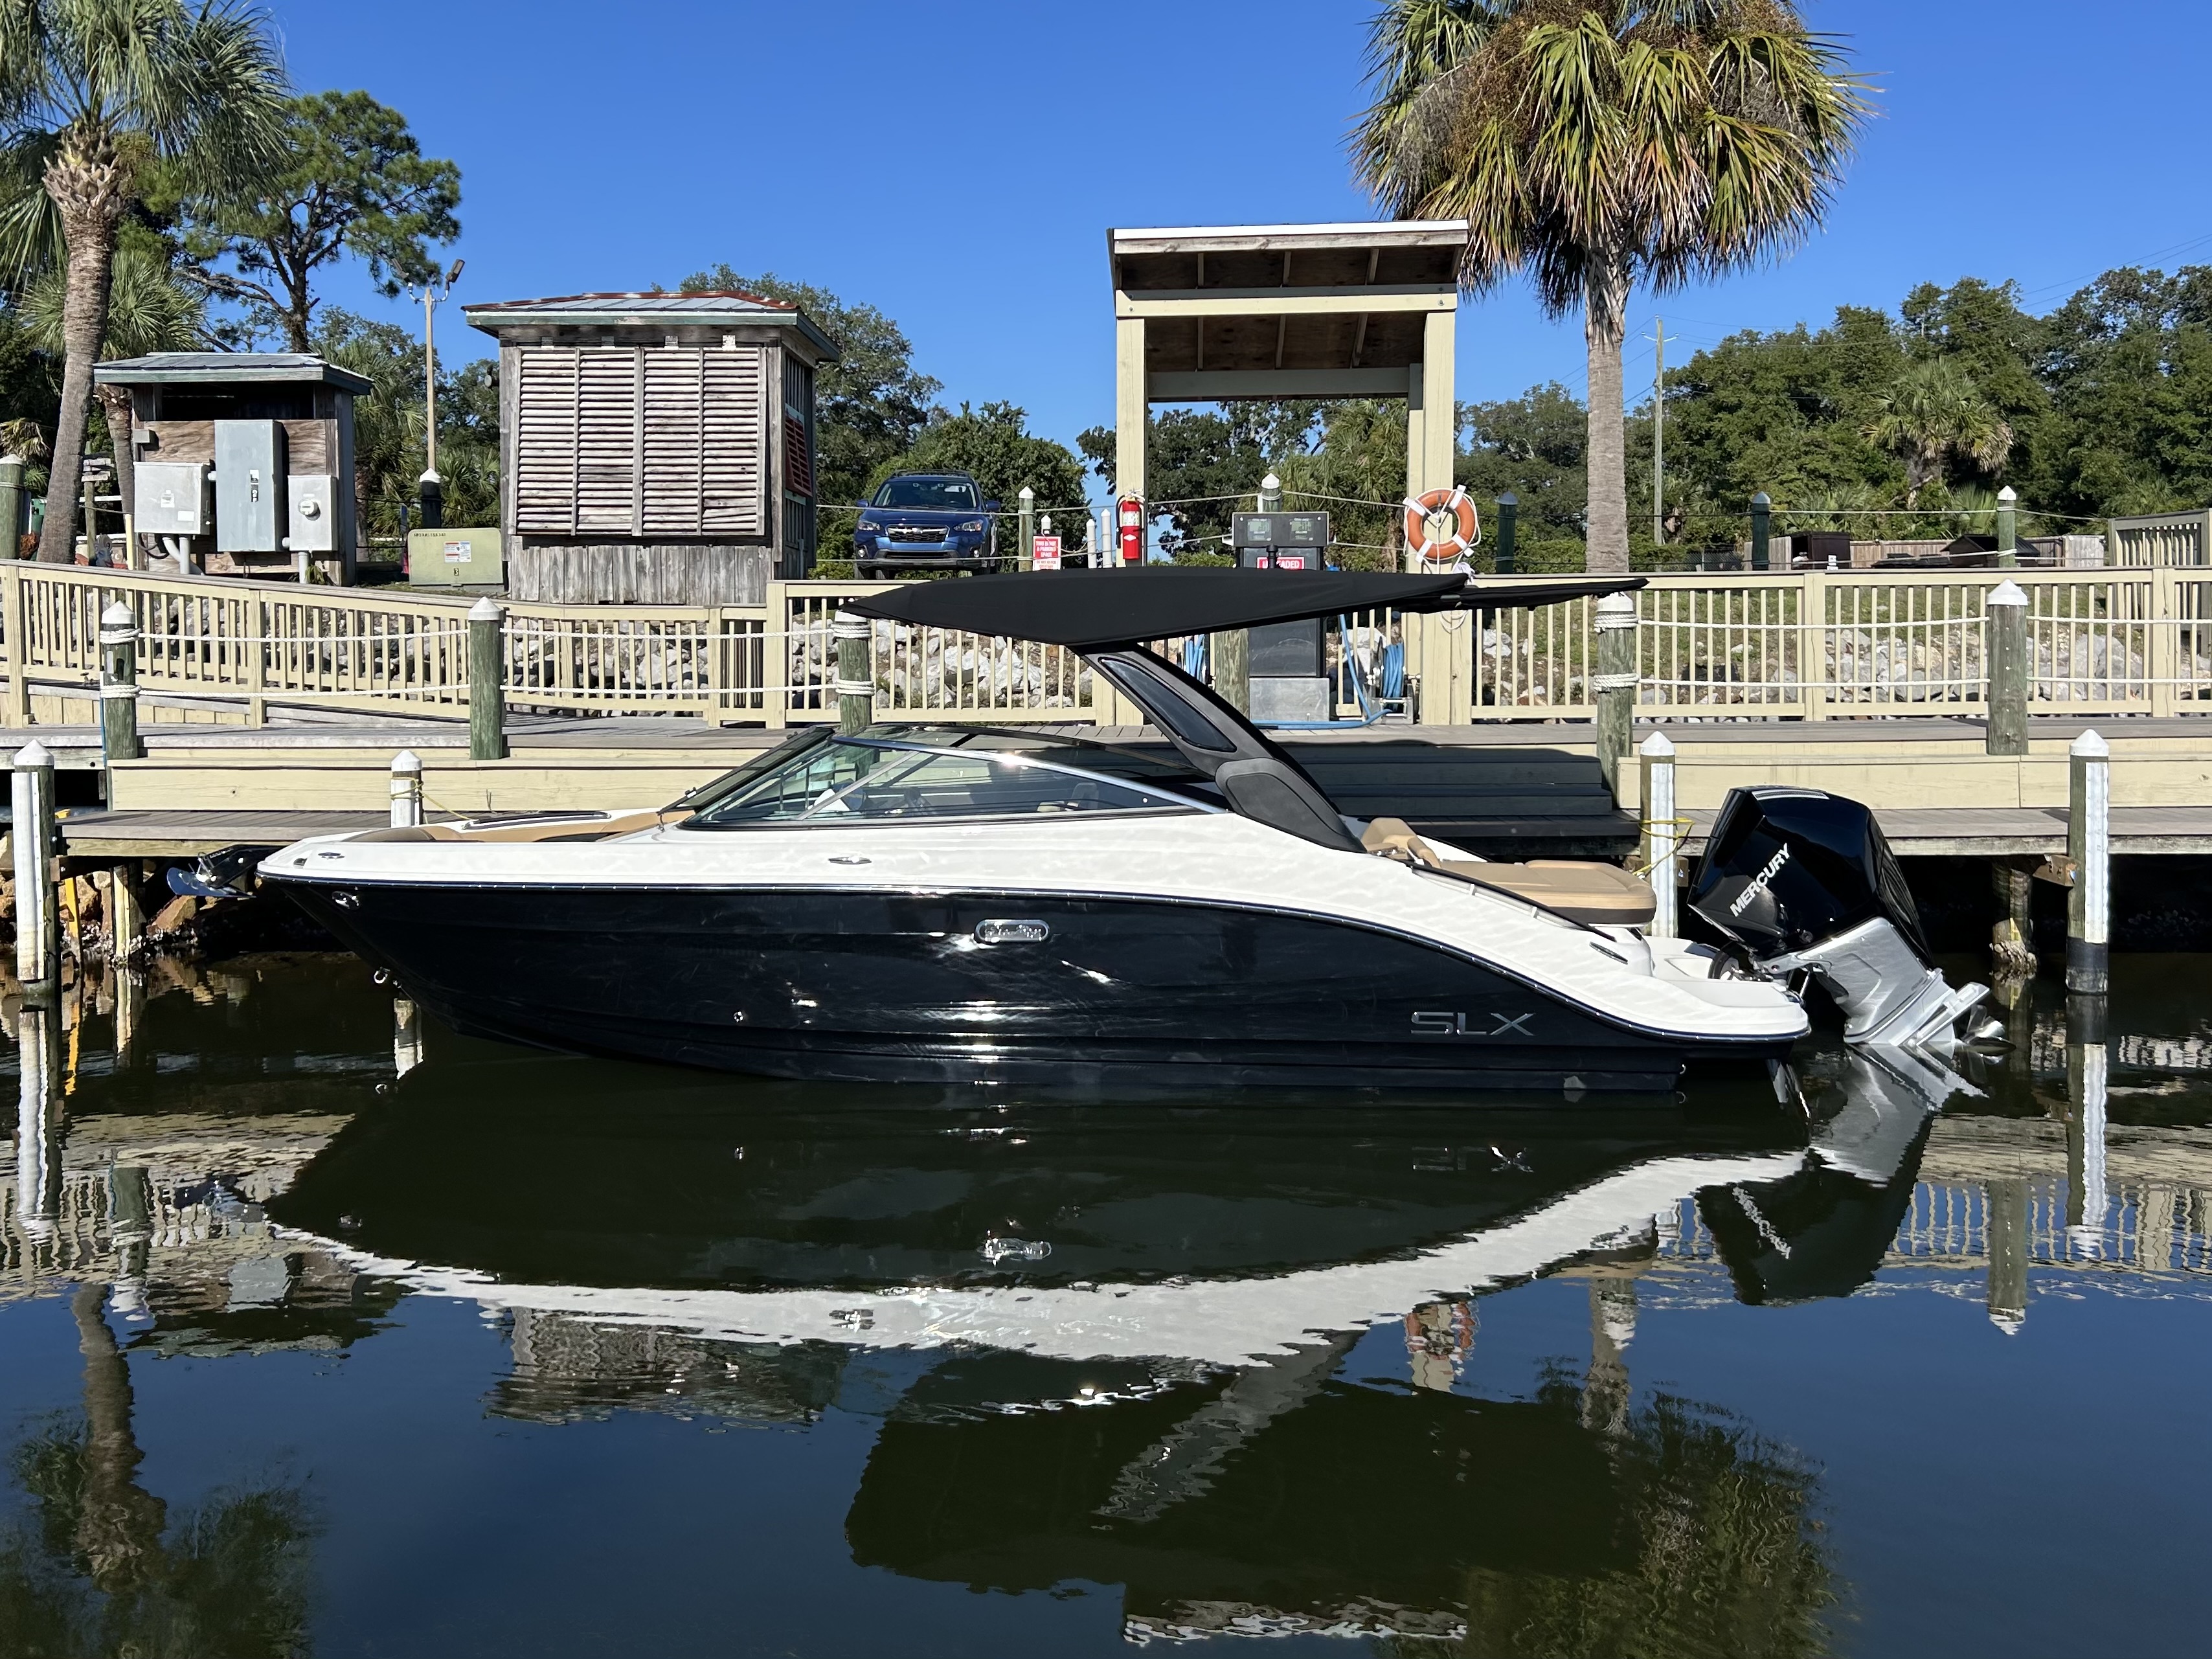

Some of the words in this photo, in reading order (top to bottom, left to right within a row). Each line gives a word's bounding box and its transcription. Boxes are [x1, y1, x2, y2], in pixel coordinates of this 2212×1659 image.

[1262, 560, 1300, 569] UADED
[1730, 842, 1790, 917] MERCURY
[1411, 1011, 1535, 1036] SLX
